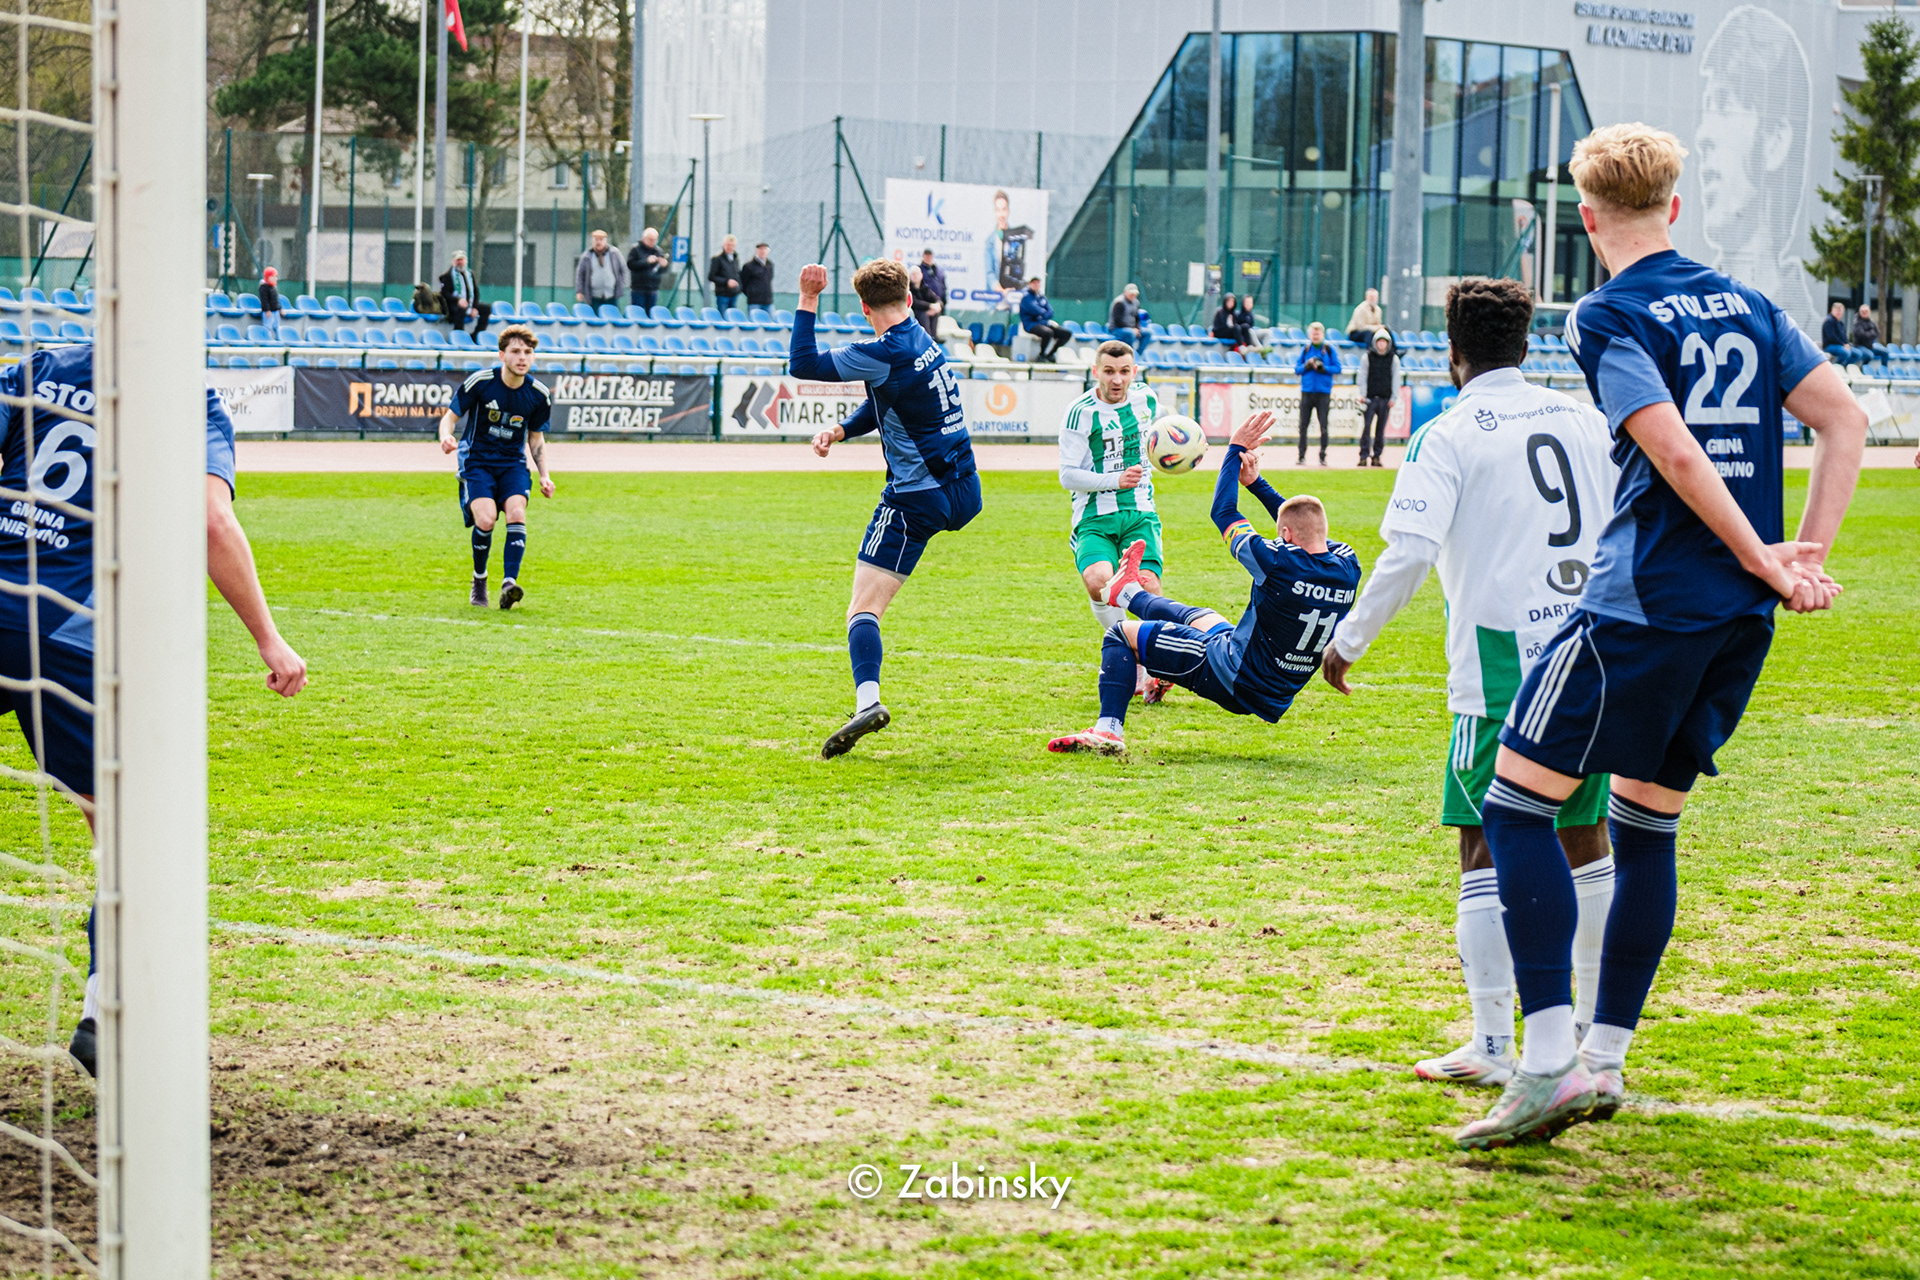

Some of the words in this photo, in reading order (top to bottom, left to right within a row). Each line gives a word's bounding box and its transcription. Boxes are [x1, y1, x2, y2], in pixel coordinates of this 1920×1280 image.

[676, 239, 688, 260] P
[1648, 292, 1752, 323] STOLEM
[250, 381, 287, 395] Wami
[555, 375, 675, 401] KRAFT&DELE
[928, 362, 960, 413] 15
[1680, 331, 1760, 425] 22
[375, 406, 407, 417] DRZWI
[410, 406, 425, 417] NA
[568, 406, 663, 428] BESTCRAFT
[1498, 407, 1545, 421] Starogard
[972, 421, 1029, 433] DARTOMEKS
[28, 420, 98, 502] 6
[1526, 433, 1582, 548] 9
[10, 500, 65, 530] GMINA
[1291, 580, 1355, 604] STOLEM
[1298, 608, 1338, 653] 11
[1285, 652, 1314, 664] GMINA
